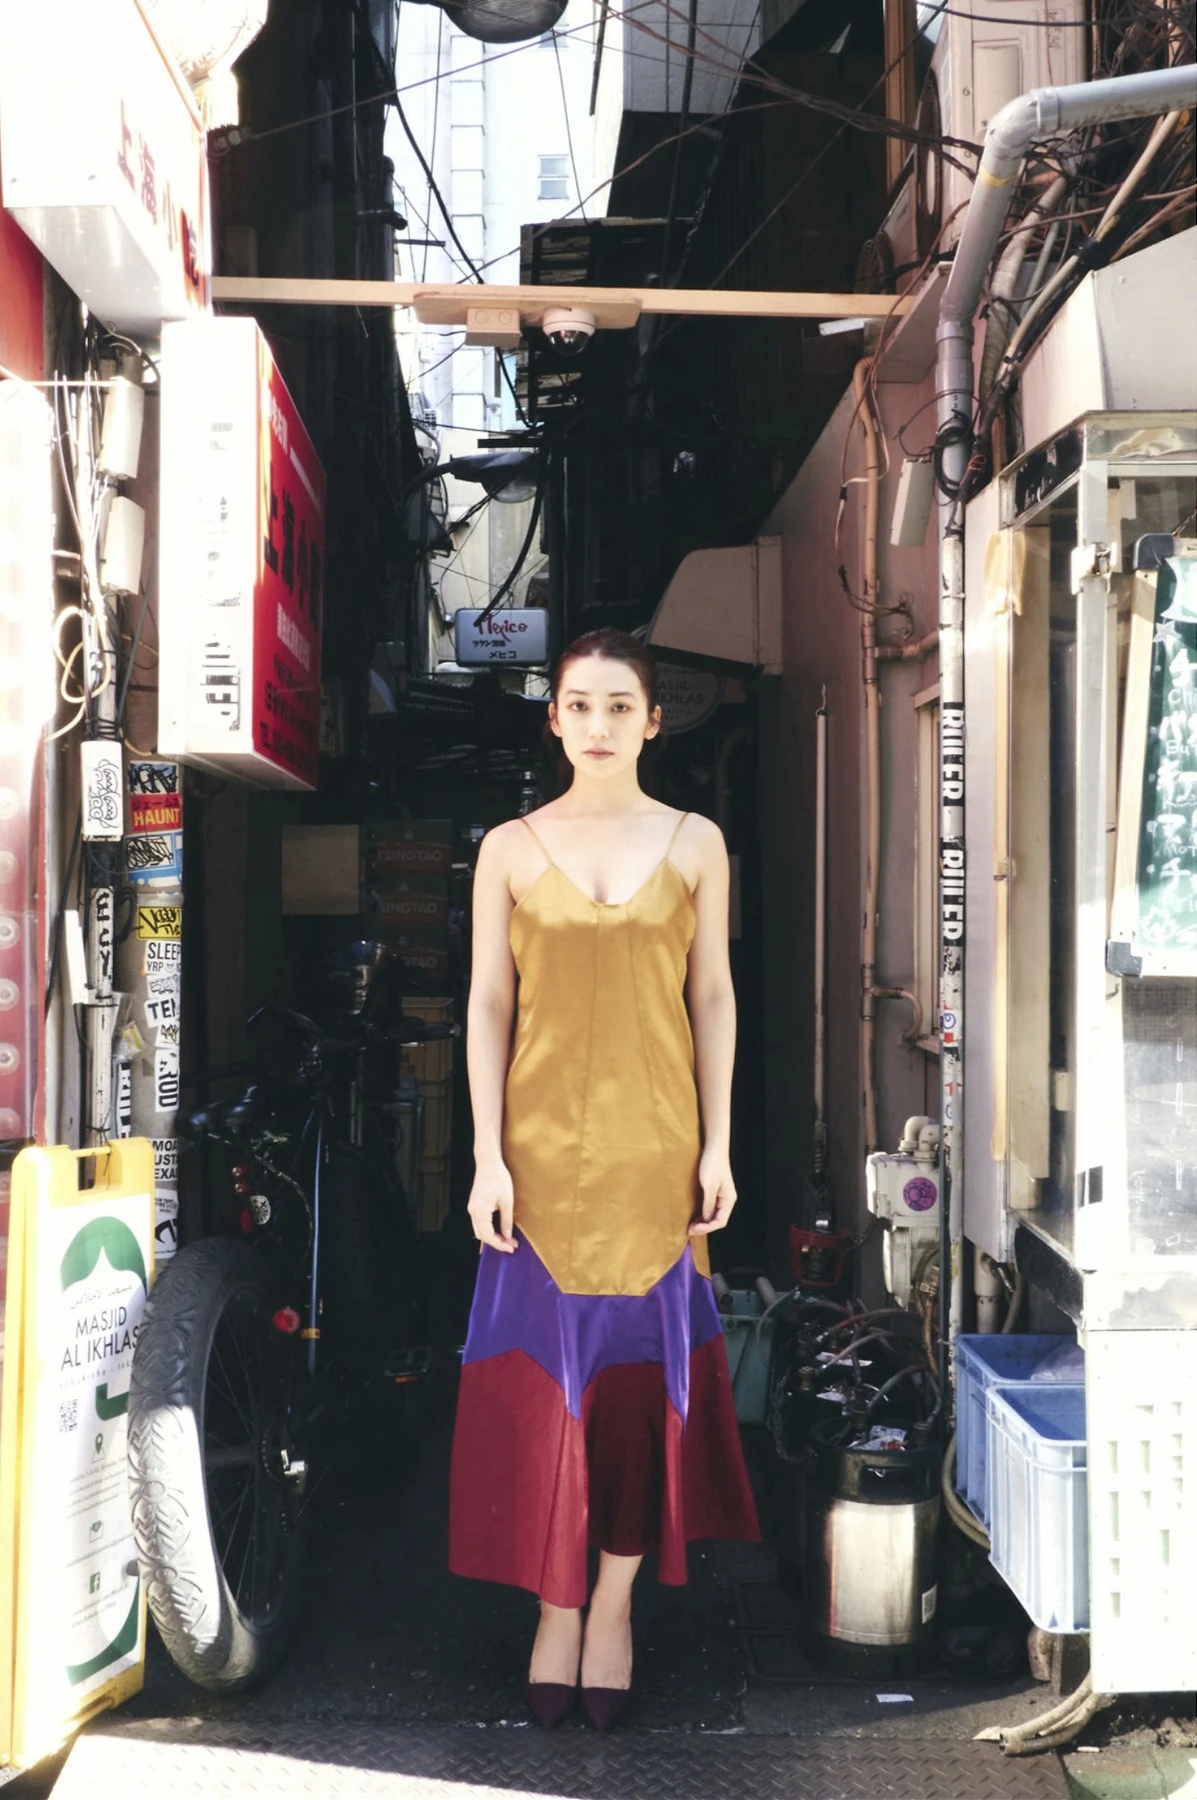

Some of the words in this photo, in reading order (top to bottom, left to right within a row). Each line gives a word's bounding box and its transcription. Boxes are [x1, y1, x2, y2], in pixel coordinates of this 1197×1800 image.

[488, 650, 517, 659] メヒコ
[657, 680, 692, 691] ASJID
[134, 808, 181, 827] HAUNT
[381, 901, 438, 914] SINGTAO
[75, 1306, 128, 1339] MASJID
[61, 1343, 82, 1371] AL
[88, 1325, 141, 1363] IKHLAS
